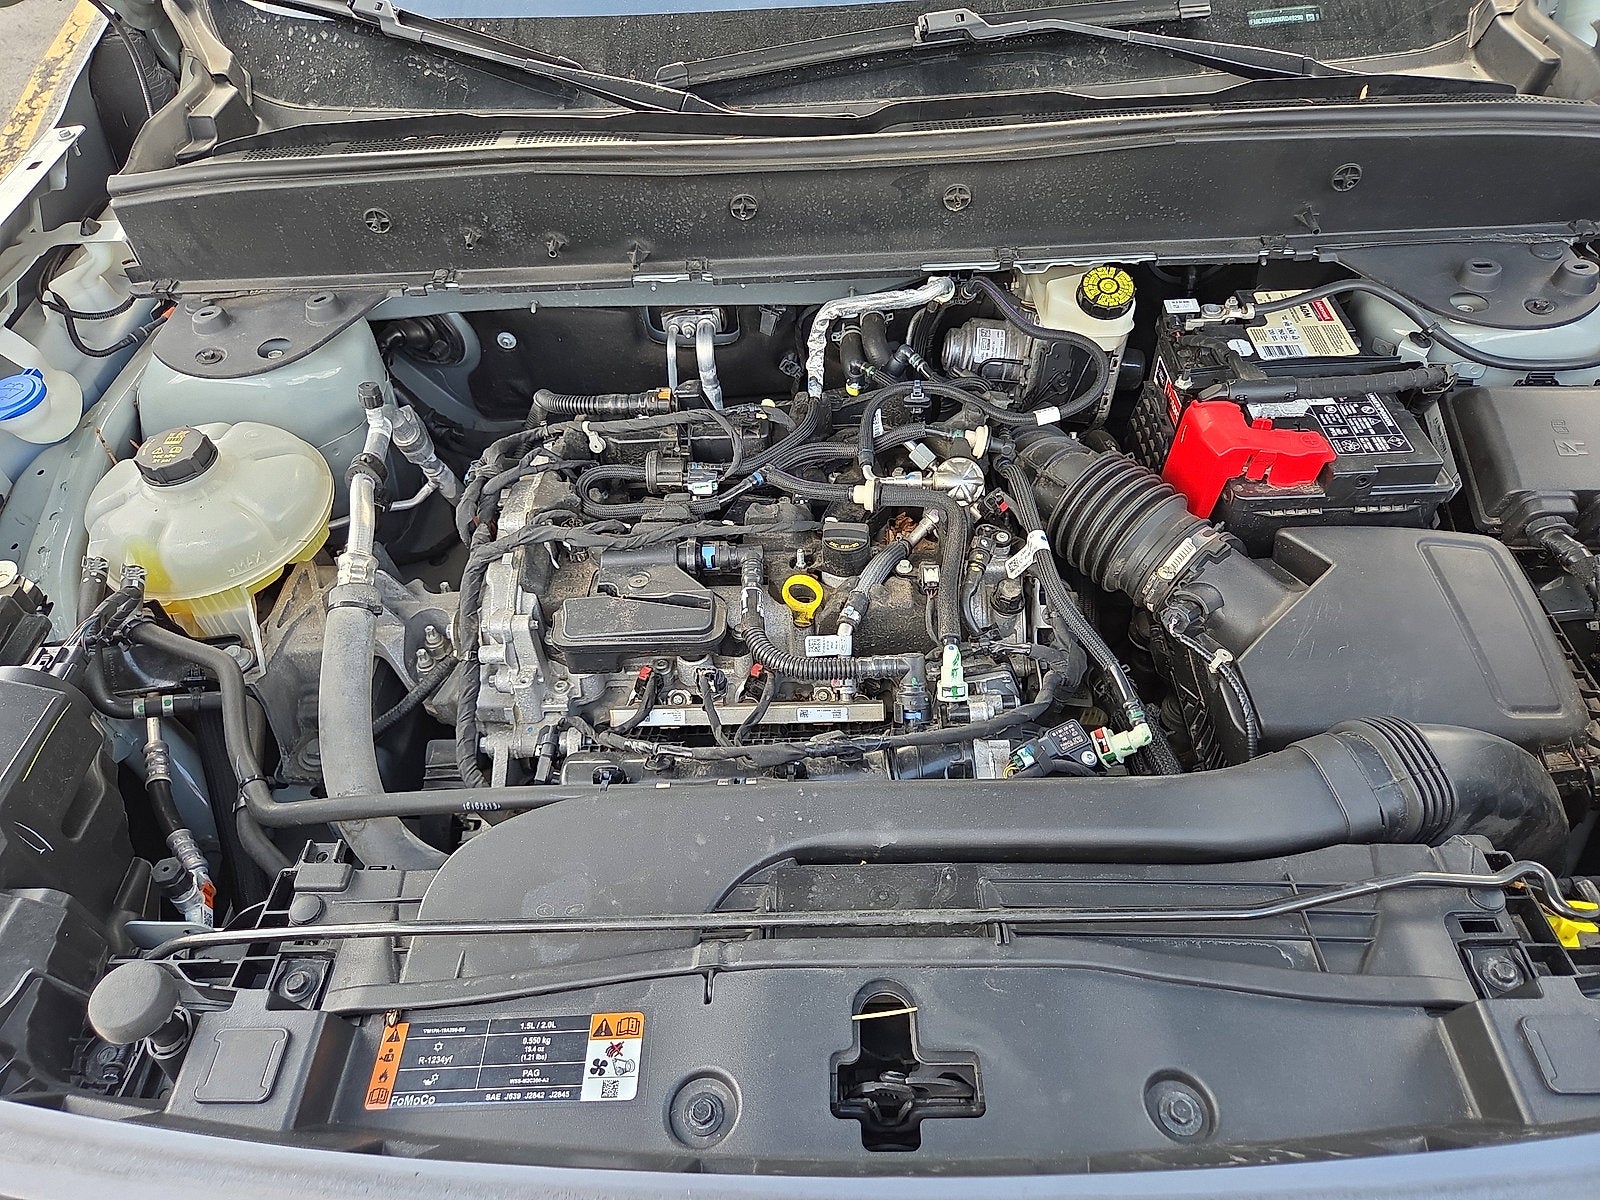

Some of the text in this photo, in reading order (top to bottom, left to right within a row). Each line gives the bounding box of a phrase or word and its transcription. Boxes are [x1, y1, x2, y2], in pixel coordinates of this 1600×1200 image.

[522, 1036, 551, 1045] 0.550 kg
[418, 1055, 454, 1065] R-1234yf
[522, 1069, 540, 1077] PAG
[390, 1094, 436, 1106] FoMoCo
[485, 1092, 502, 1101] SAE
